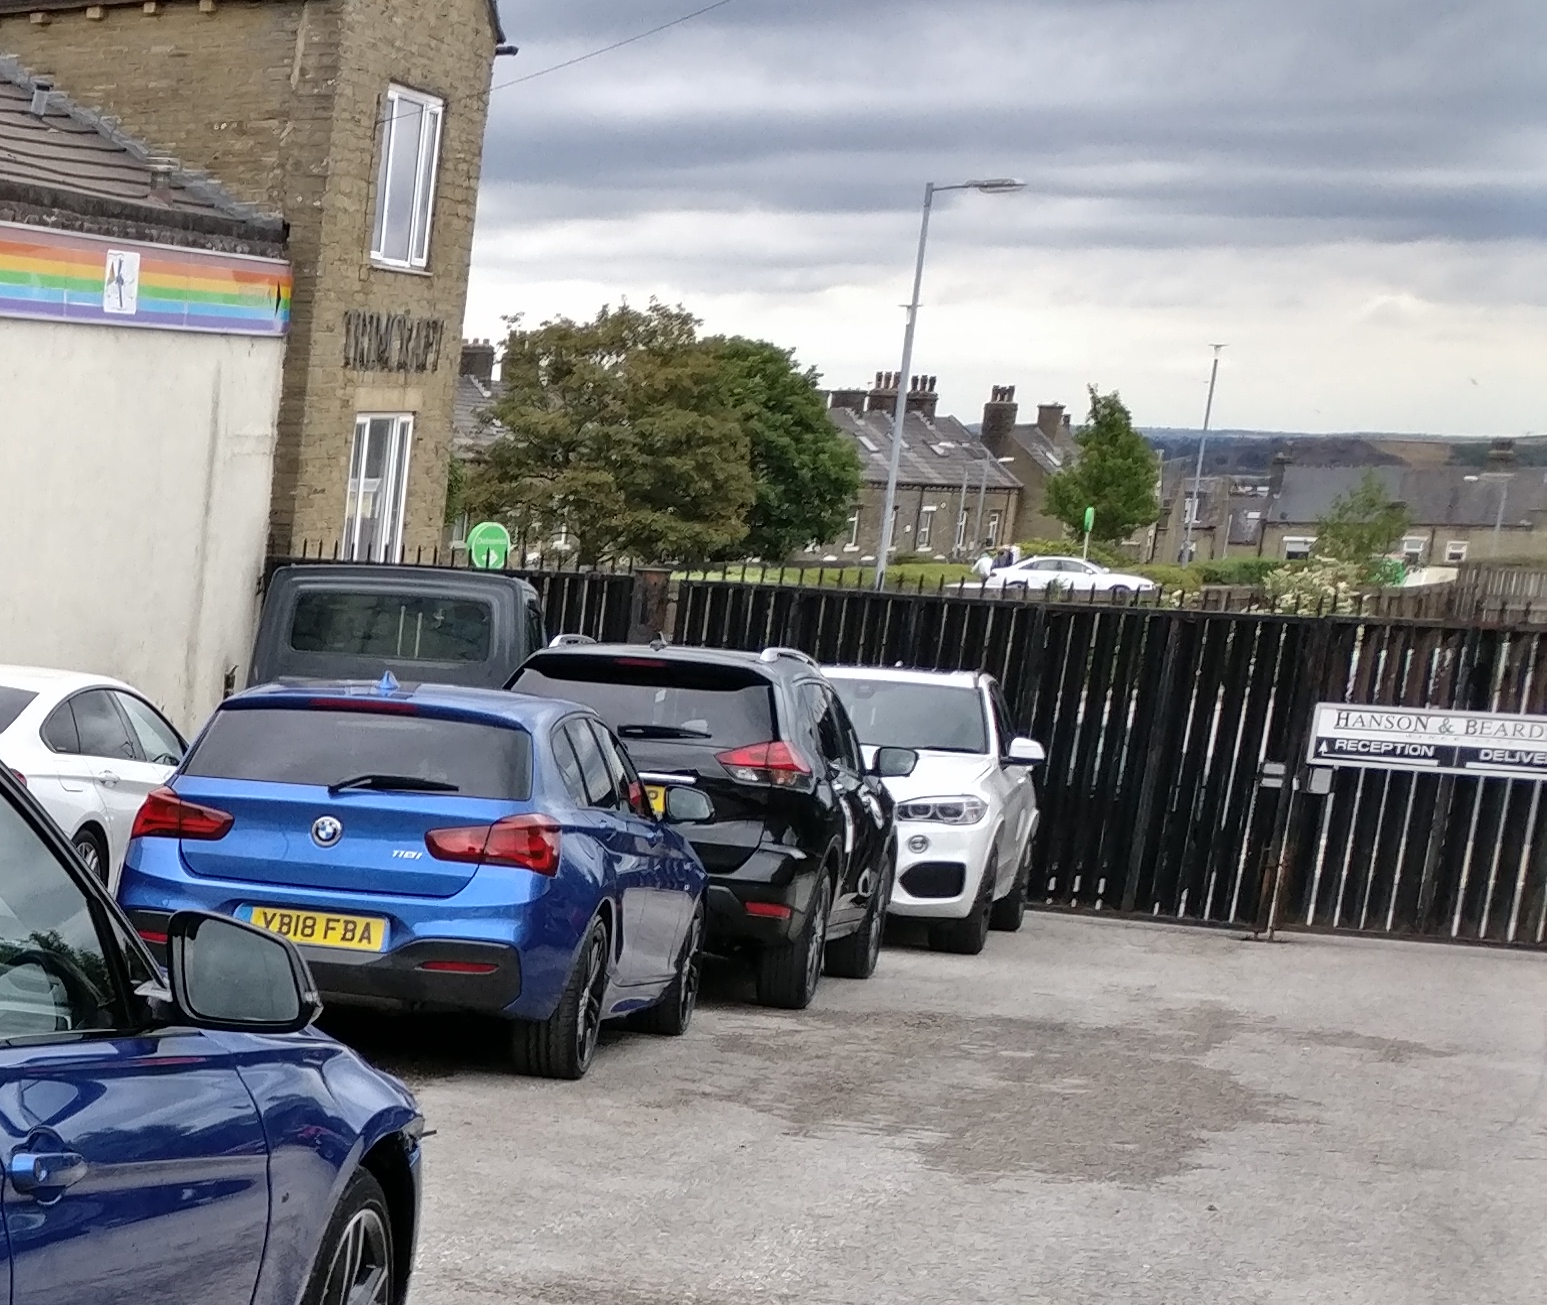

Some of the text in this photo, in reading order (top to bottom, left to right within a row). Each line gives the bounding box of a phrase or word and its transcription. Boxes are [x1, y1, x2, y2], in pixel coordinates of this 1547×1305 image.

[1334, 709, 1429, 733] HANSON
[1438, 717, 1455, 735] &
[1464, 719, 1547, 740] BEARD
[1334, 739, 1435, 757] RECEPTION
[1479, 748, 1547, 765] DELIVE
[262, 910, 372, 945] YB18 FBA
